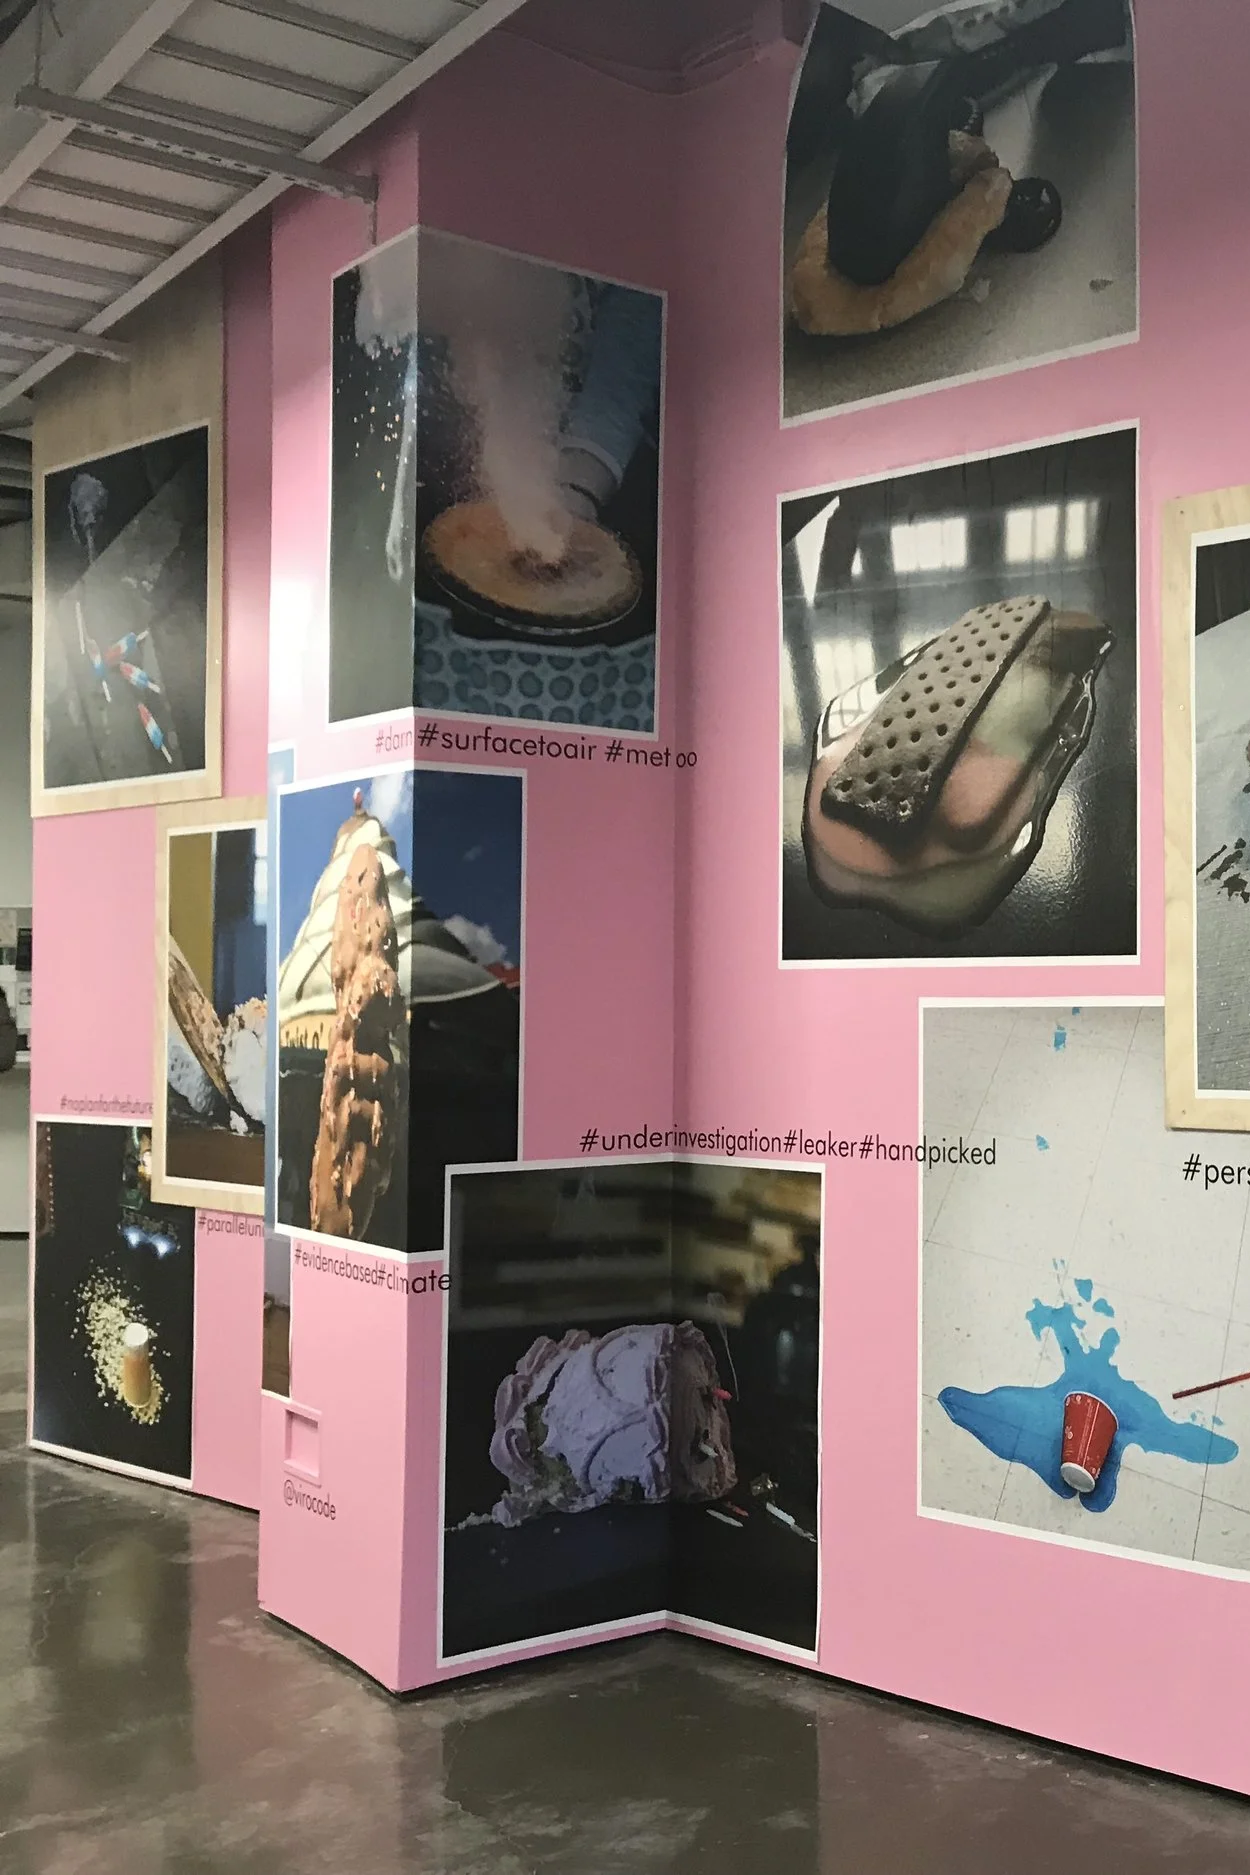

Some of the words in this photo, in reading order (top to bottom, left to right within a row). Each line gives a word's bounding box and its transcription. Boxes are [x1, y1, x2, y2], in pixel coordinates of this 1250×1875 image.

[375, 724, 413, 754] #darn
[418, 722, 597, 761] #surfacetoair
[283, 1479, 336, 1520] @virocode
